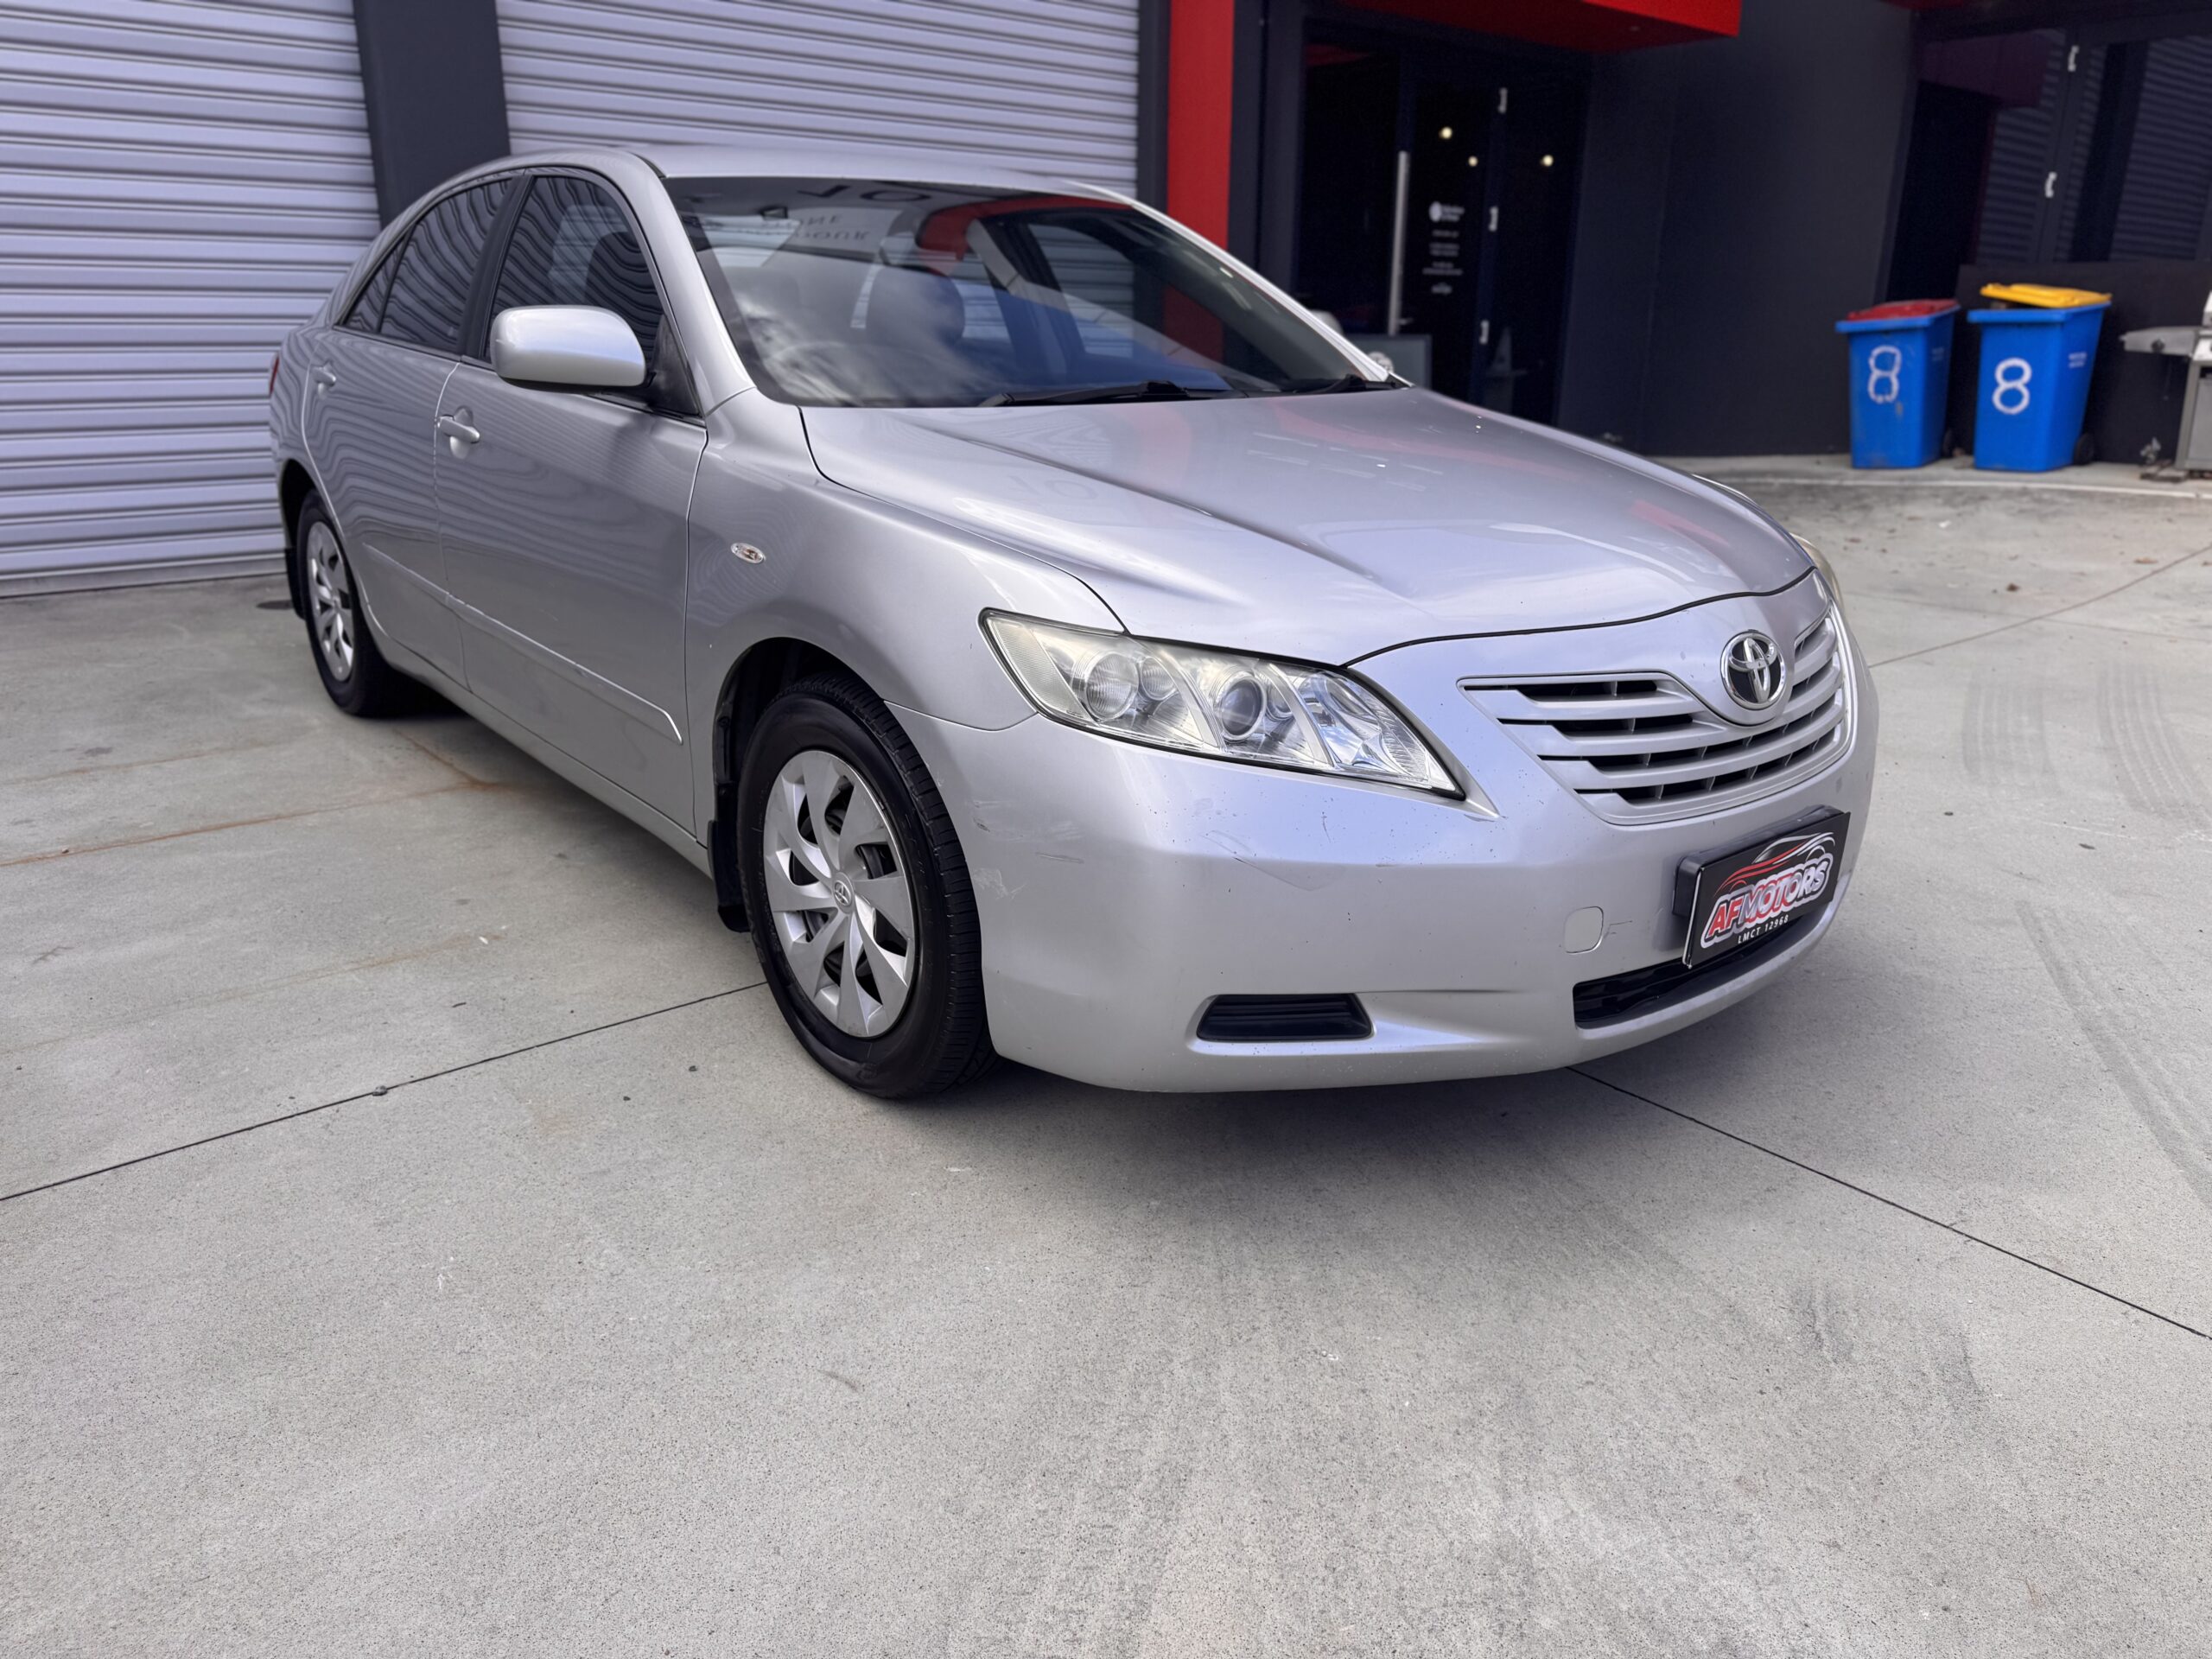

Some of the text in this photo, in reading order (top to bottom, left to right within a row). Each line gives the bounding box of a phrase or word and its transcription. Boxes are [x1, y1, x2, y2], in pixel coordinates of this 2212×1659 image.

[1868, 345, 1902, 404] 8
[1993, 358, 2032, 415] 8
[1738, 914, 1789, 944] LMCT 12968
